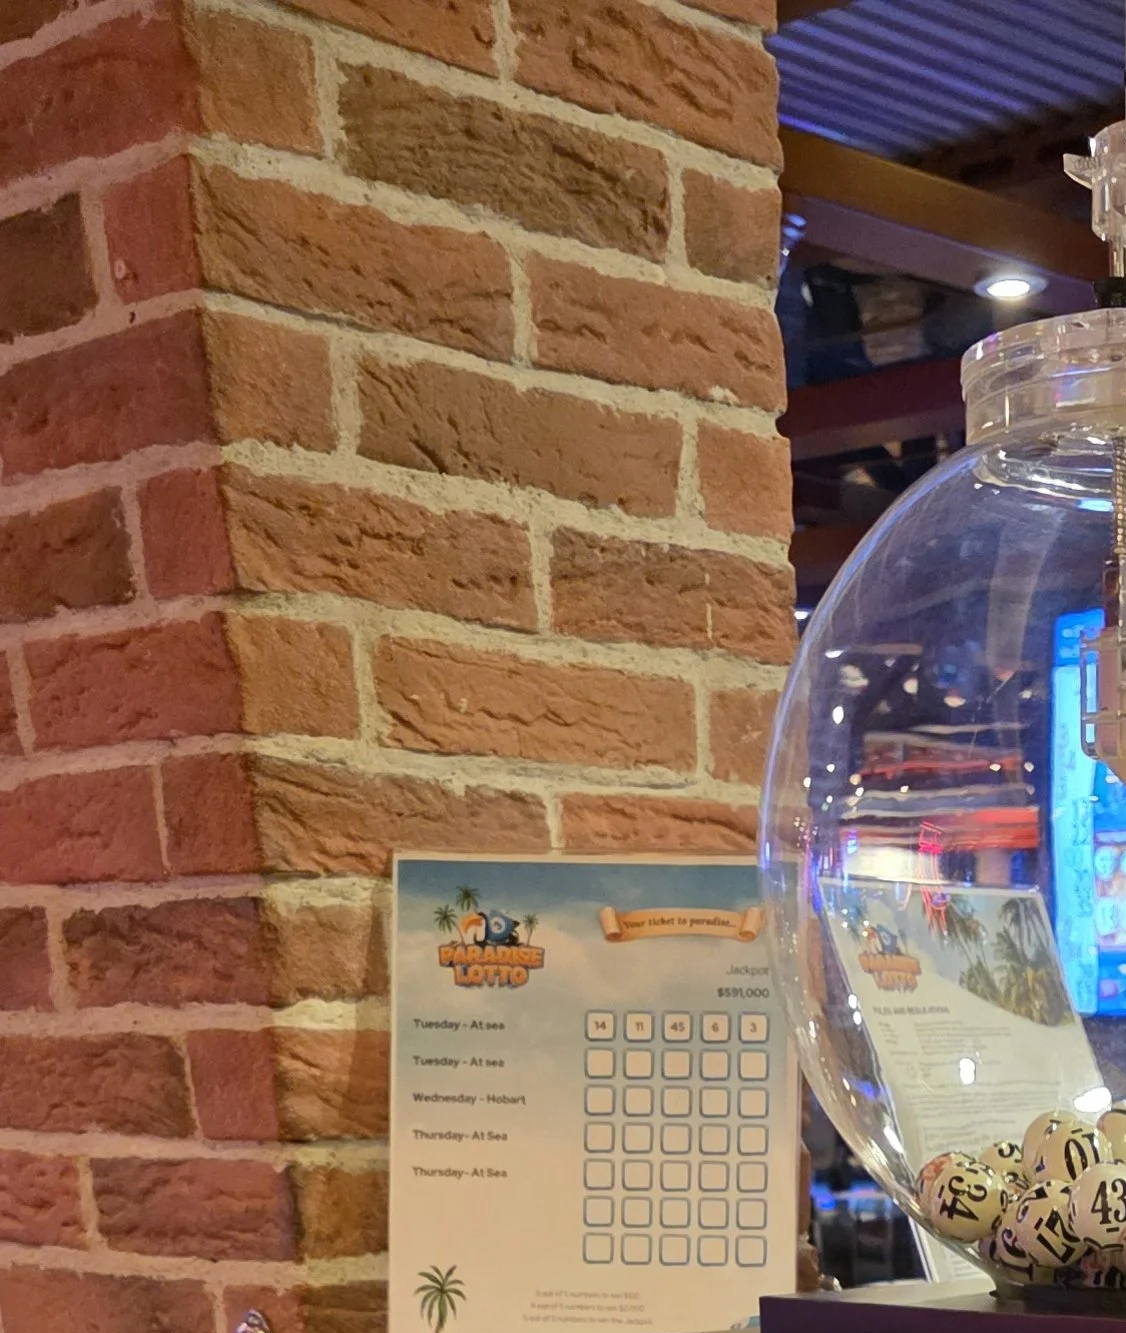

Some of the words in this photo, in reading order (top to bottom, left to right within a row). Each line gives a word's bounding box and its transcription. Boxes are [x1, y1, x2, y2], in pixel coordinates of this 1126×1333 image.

[677, 917, 688, 926] to
[438, 943, 545, 969] PARADISE
[454, 964, 530, 987] LOTTO
[726, 964, 769, 977] Jackpot
[717, 987, 770, 1000] $591,000
[413, 1018, 460, 1032] Tuesday
[470, 1020, 484, 1030] At
[485, 1022, 505, 1030] sea
[594, 1020, 607, 1031] 14
[670, 1022, 685, 1032] 45
[711, 1022, 720, 1032] 6
[413, 1055, 460, 1068] Tuesday
[470, 1057, 483, 1067] At
[413, 1092, 477, 1106] Wednesday
[486, 1094, 526, 1105] Hobart
[472, 1131, 485, 1140] At
[487, 1131, 508, 1141] Sea
[471, 1168, 484, 1178] At
[487, 1168, 508, 1178] Sea
